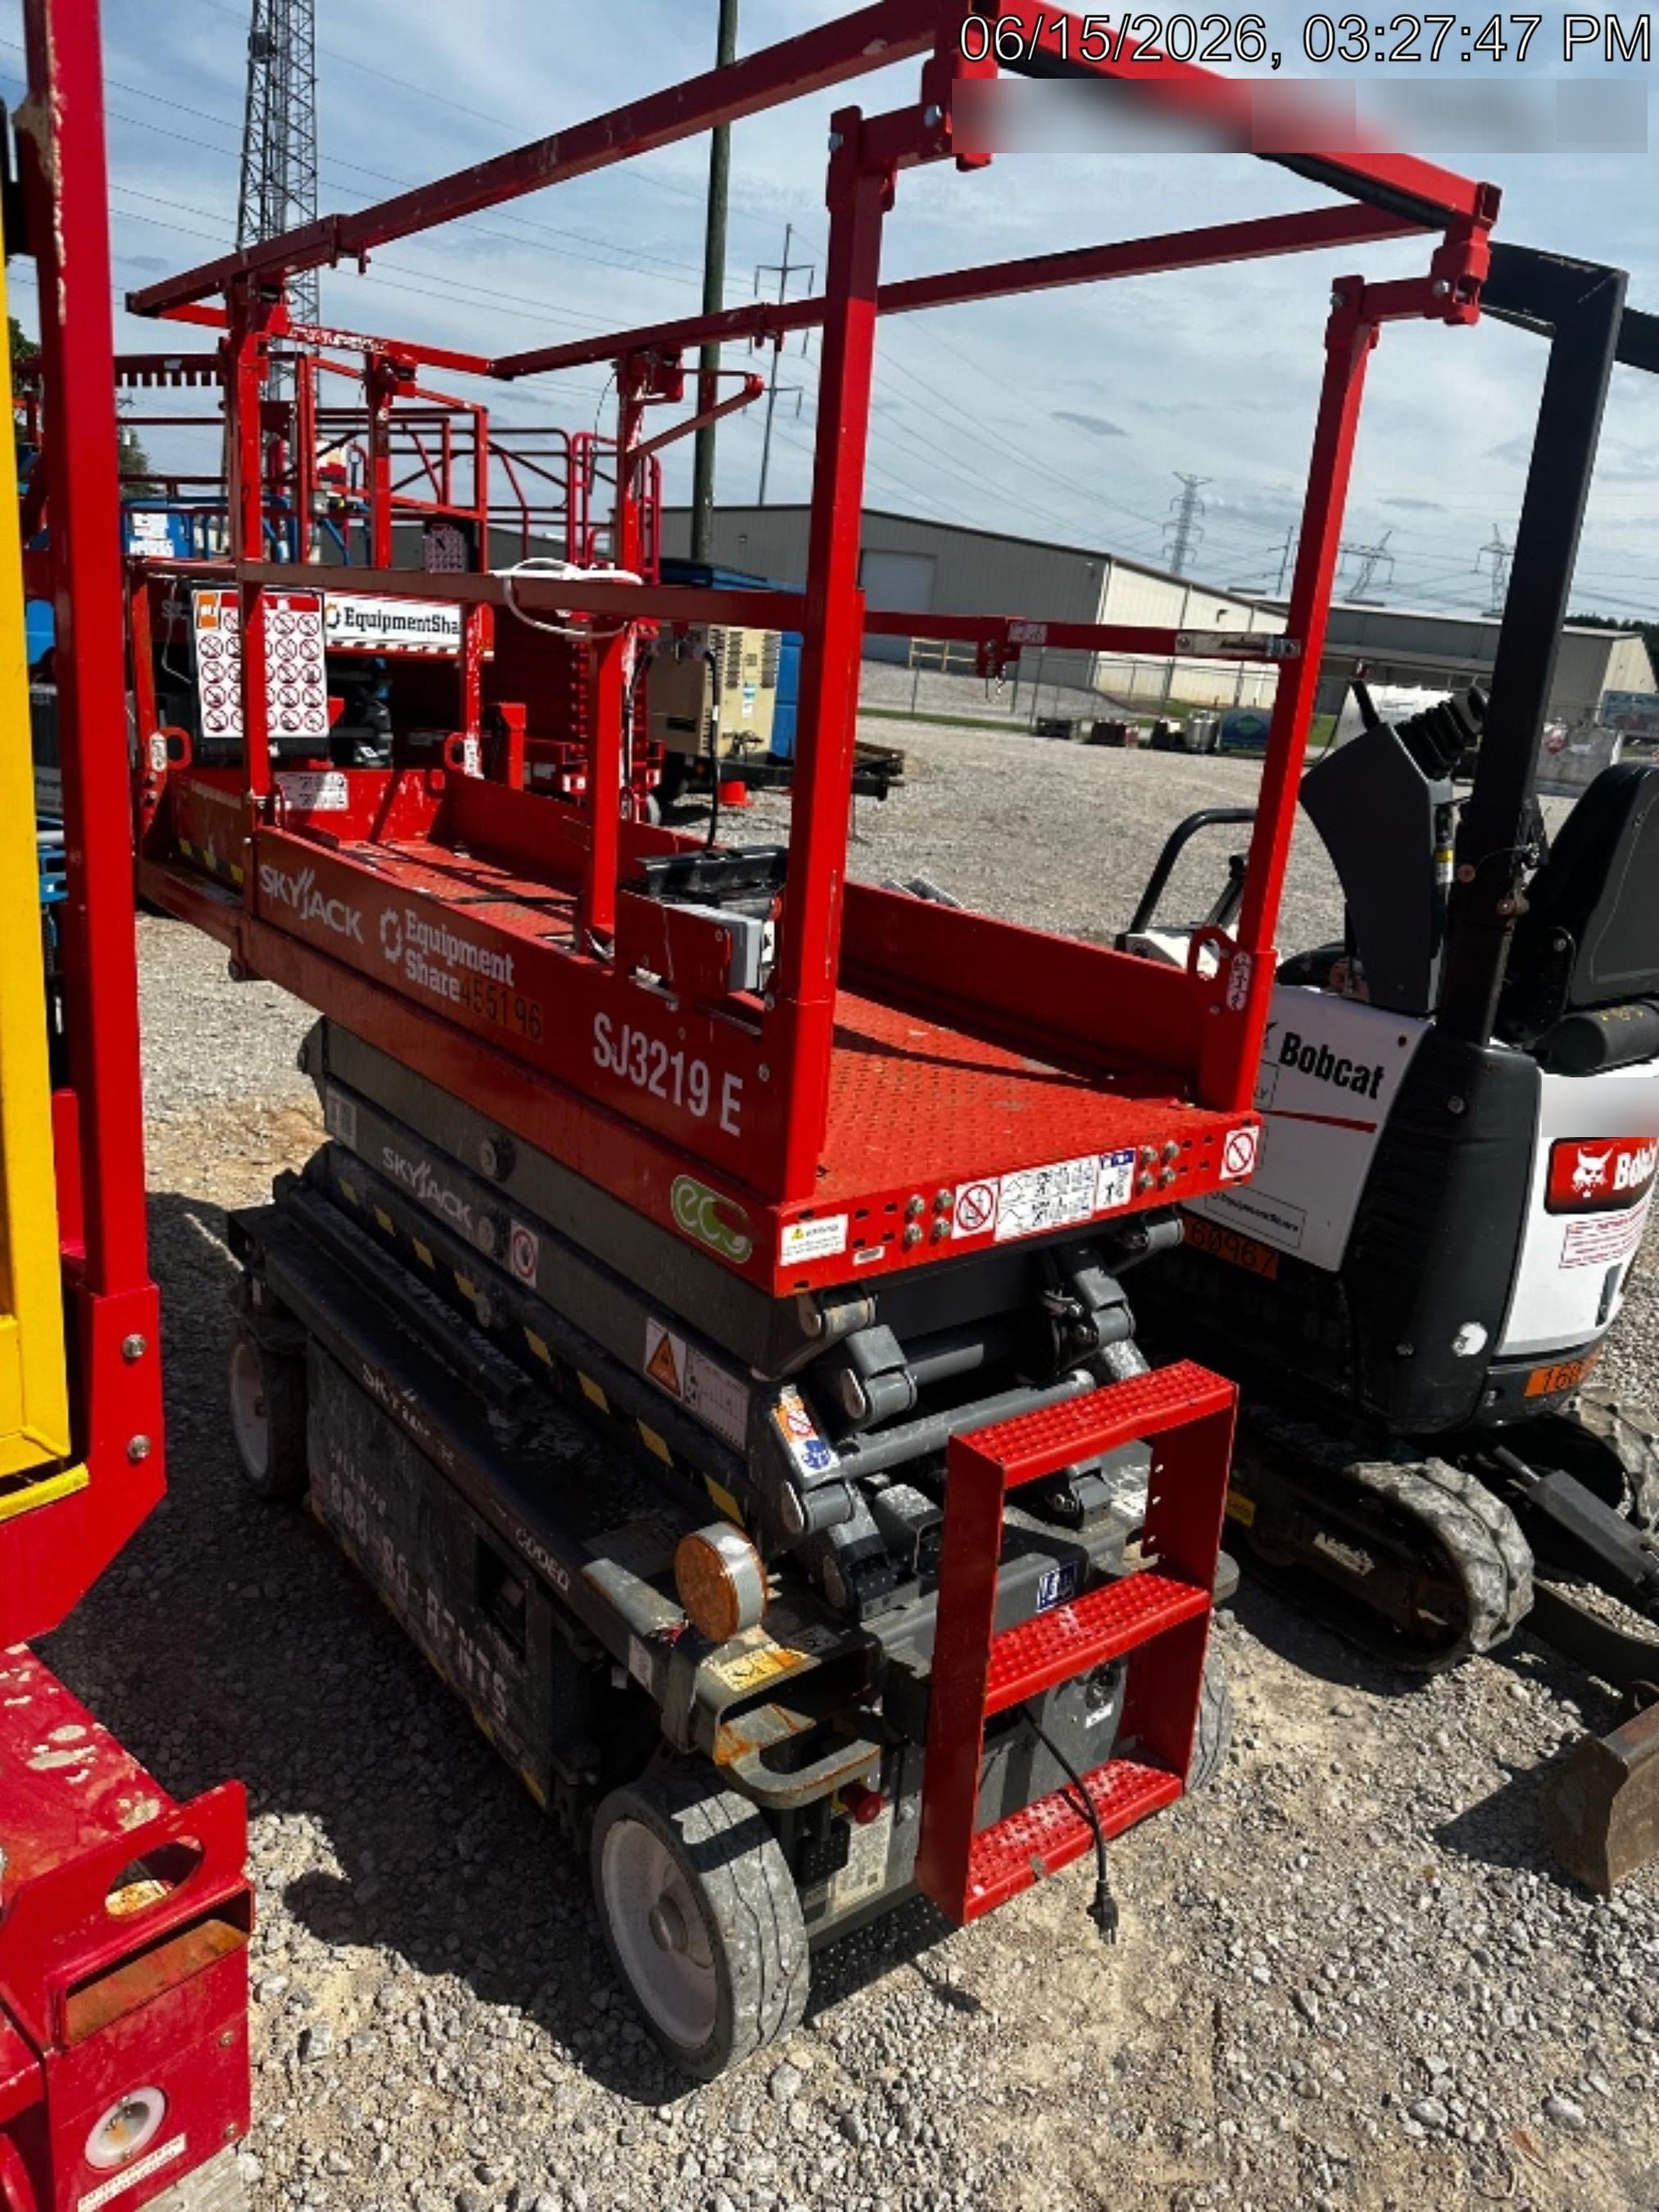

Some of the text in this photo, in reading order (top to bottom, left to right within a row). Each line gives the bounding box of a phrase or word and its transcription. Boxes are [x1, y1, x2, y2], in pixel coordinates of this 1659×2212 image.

[343, 606, 460, 635] EquipmentSha
[259, 863, 365, 945] SKYJACK
[405, 909, 514, 987] Equipment
[406, 948, 461, 1003] Share
[592, 1012, 744, 1139] SJ3219 E
[1278, 1031, 1385, 1100] Bobcat
[382, 1147, 473, 1230] SKYJACK
